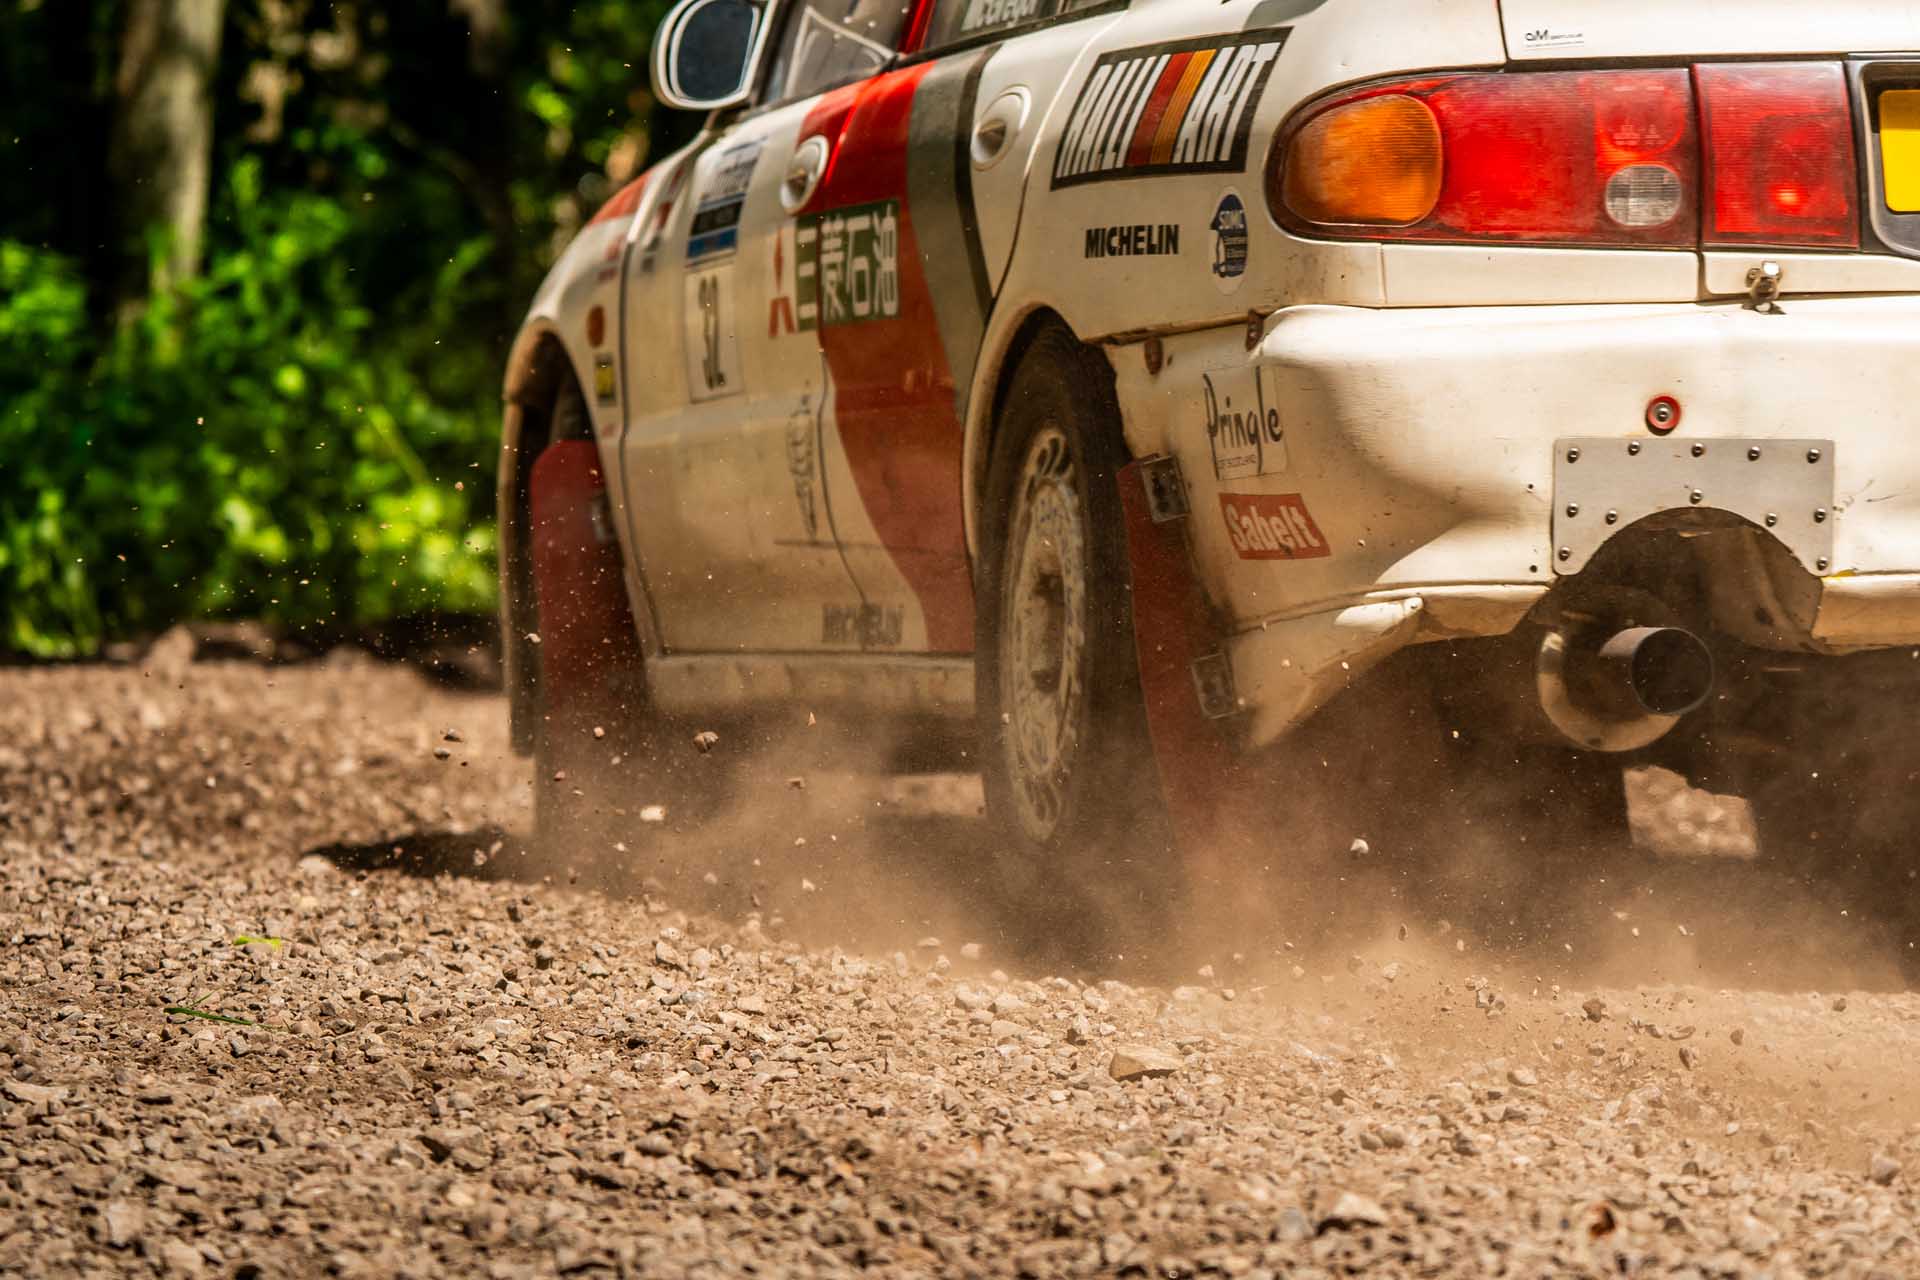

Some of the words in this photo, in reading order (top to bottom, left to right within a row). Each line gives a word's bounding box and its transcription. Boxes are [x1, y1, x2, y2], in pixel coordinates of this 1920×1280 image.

[1084, 224, 1180, 258] MICHELIN
[1202, 366, 1284, 481] Pringle
[1226, 503, 1321, 551] Sabelt
